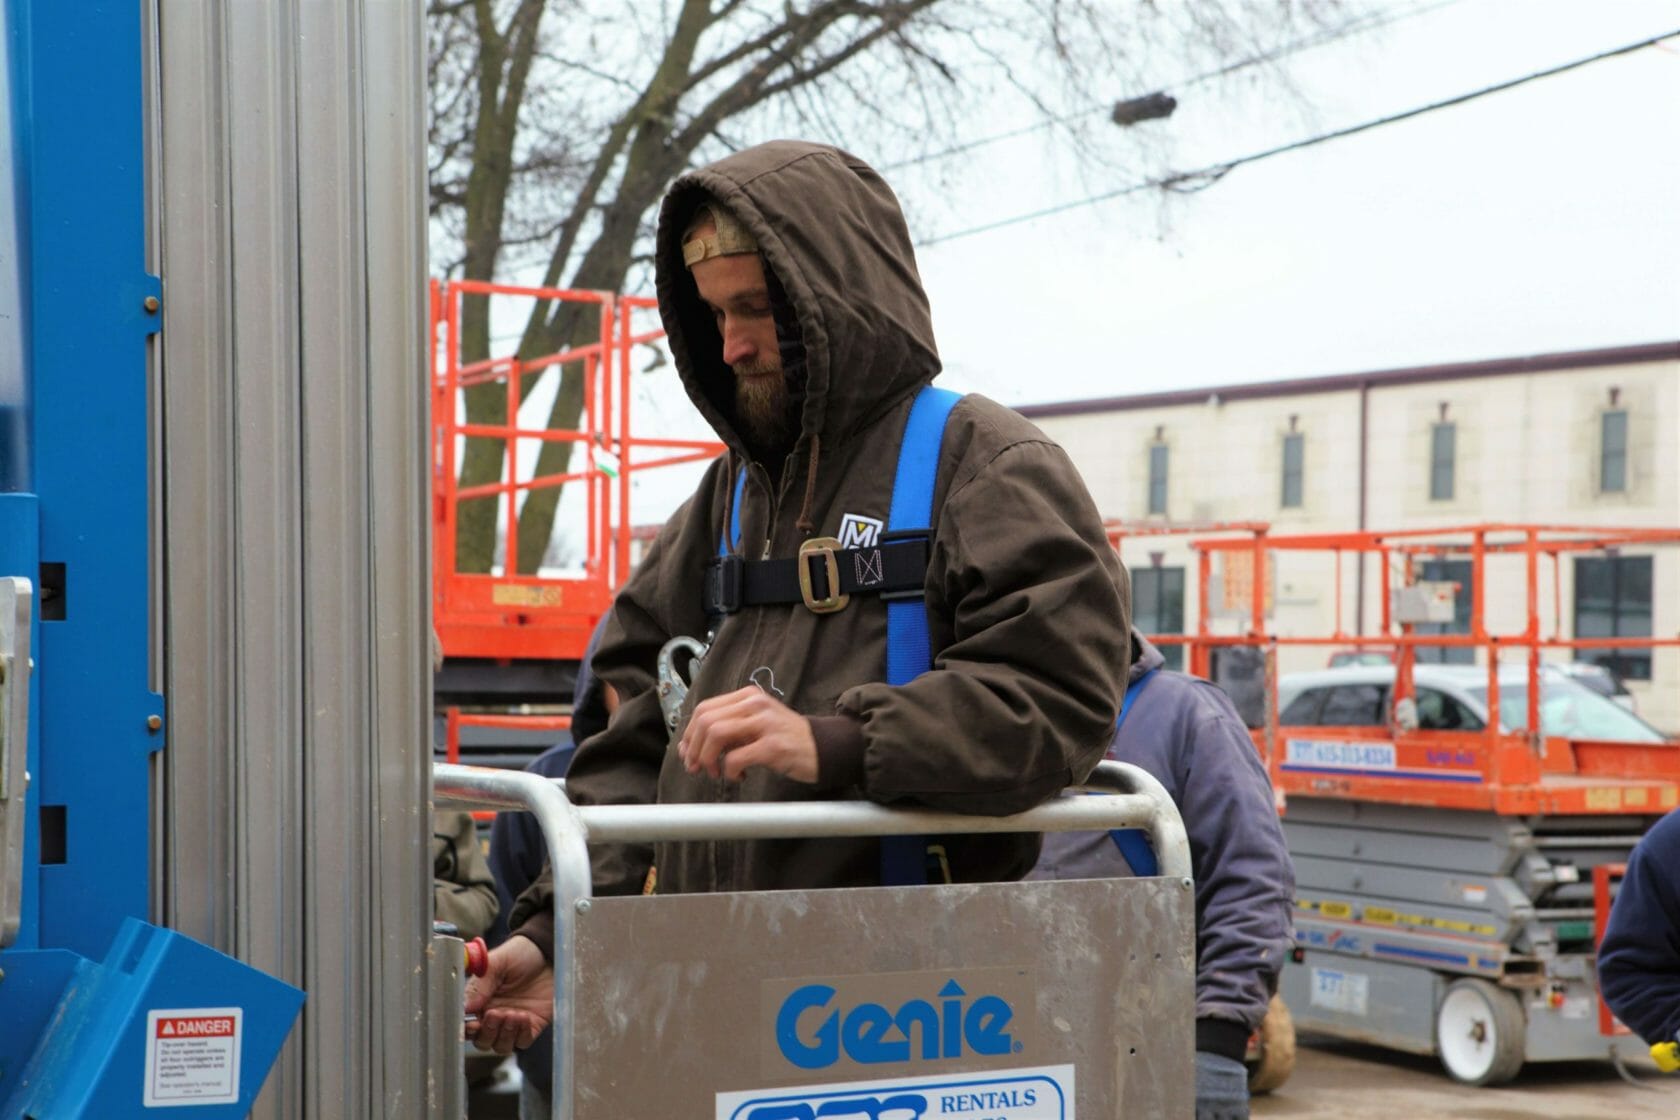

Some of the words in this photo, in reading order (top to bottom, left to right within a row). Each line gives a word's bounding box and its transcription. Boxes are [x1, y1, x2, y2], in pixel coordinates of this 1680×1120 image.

[176, 1020, 231, 1034] DANGER
[776, 978, 1014, 1069] Genie
[941, 1088, 1036, 1113] RENTALS
